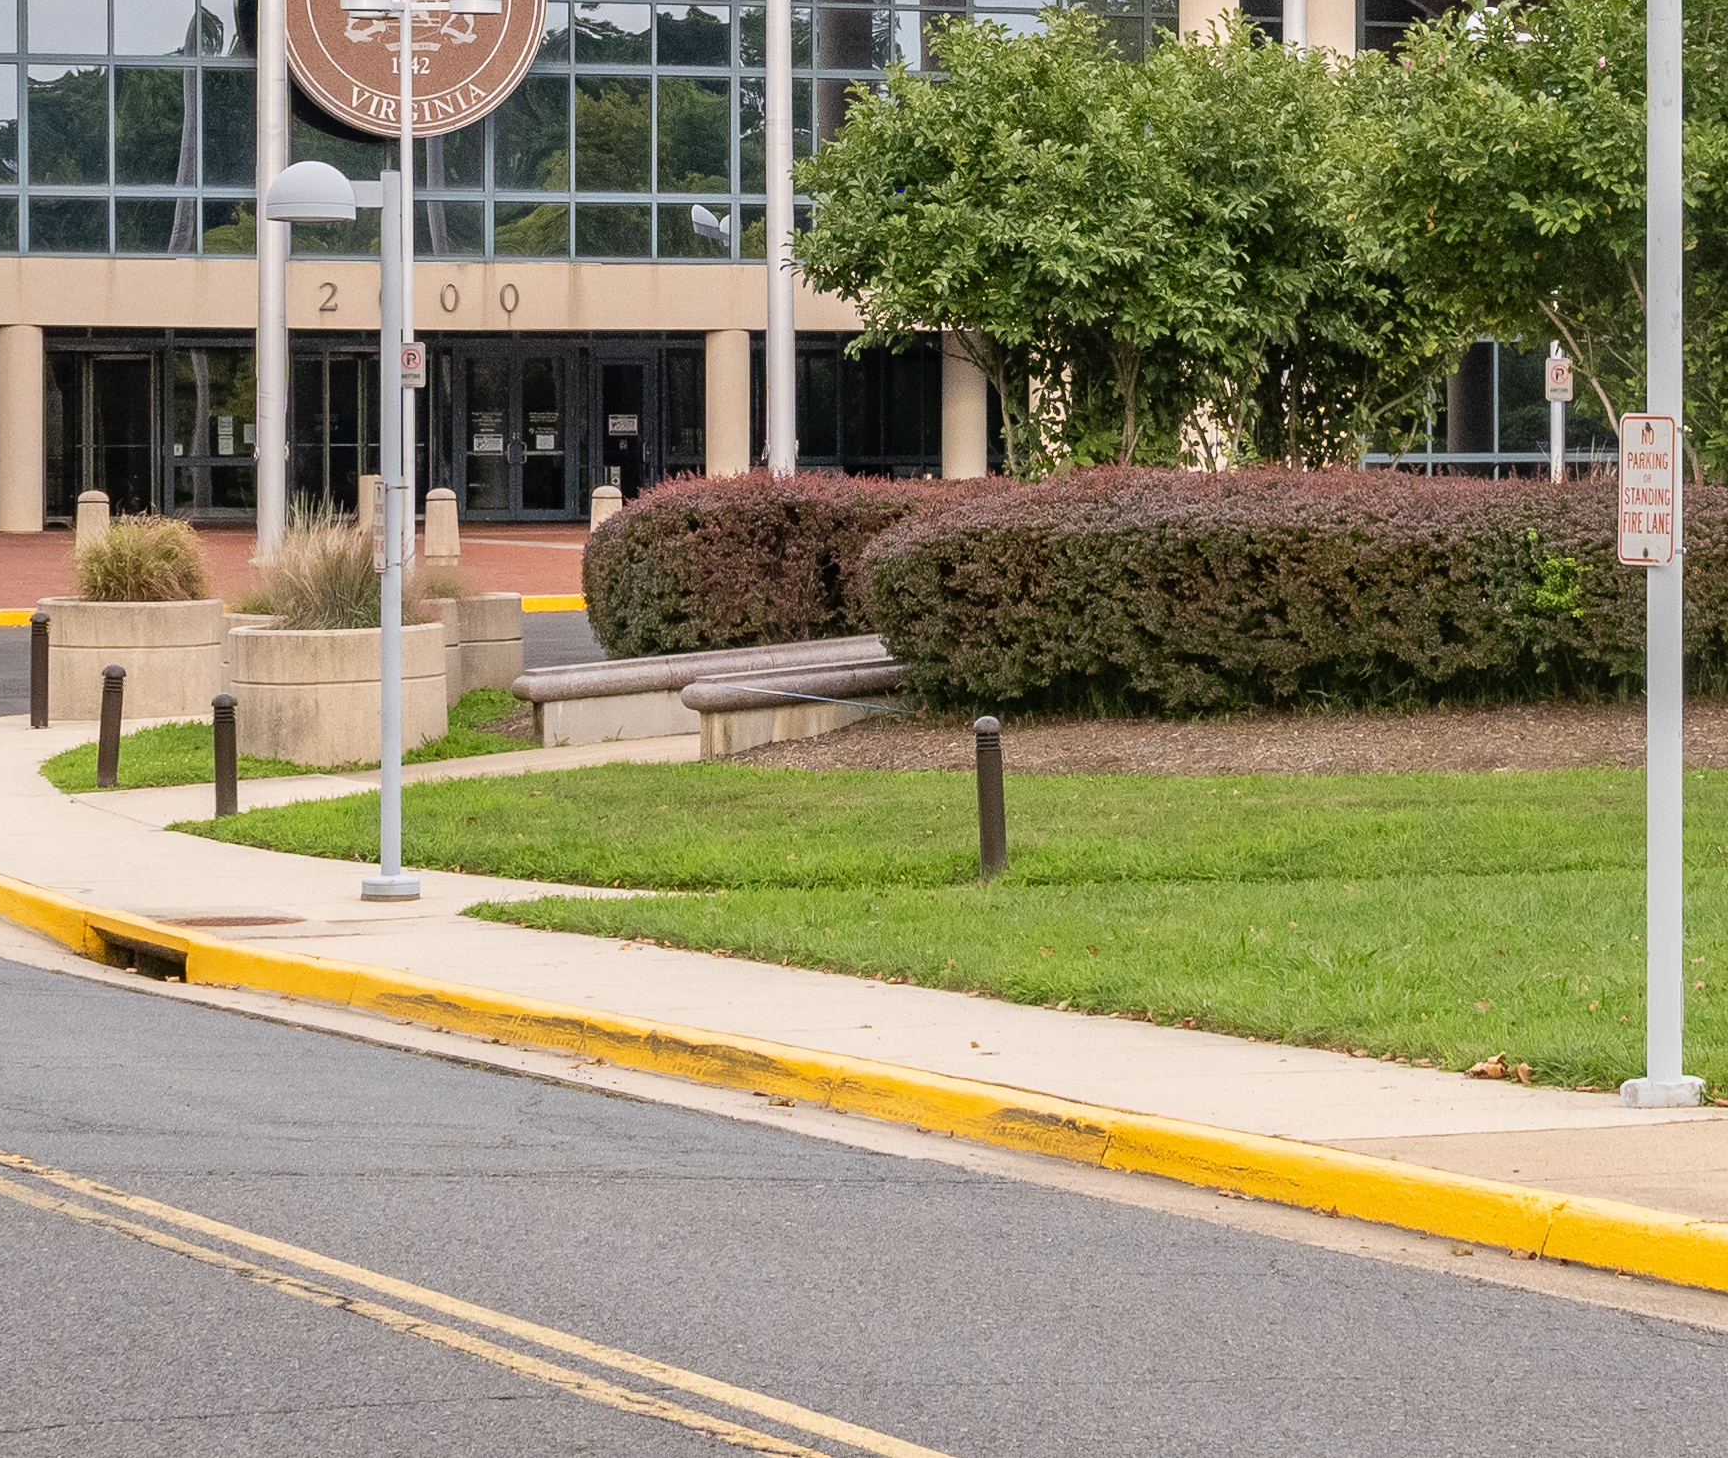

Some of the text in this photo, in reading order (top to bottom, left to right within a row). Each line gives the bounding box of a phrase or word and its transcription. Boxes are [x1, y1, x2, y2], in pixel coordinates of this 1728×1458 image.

[391, 57, 431, 75] 142
[1641, 428, 1655, 446] NO
[1627, 451, 1669, 470] PARKING
[1643, 474, 1652, 484] OR
[1624, 487, 1671, 506] STANDING
[1623, 511, 1671, 535] FIRE LANE
